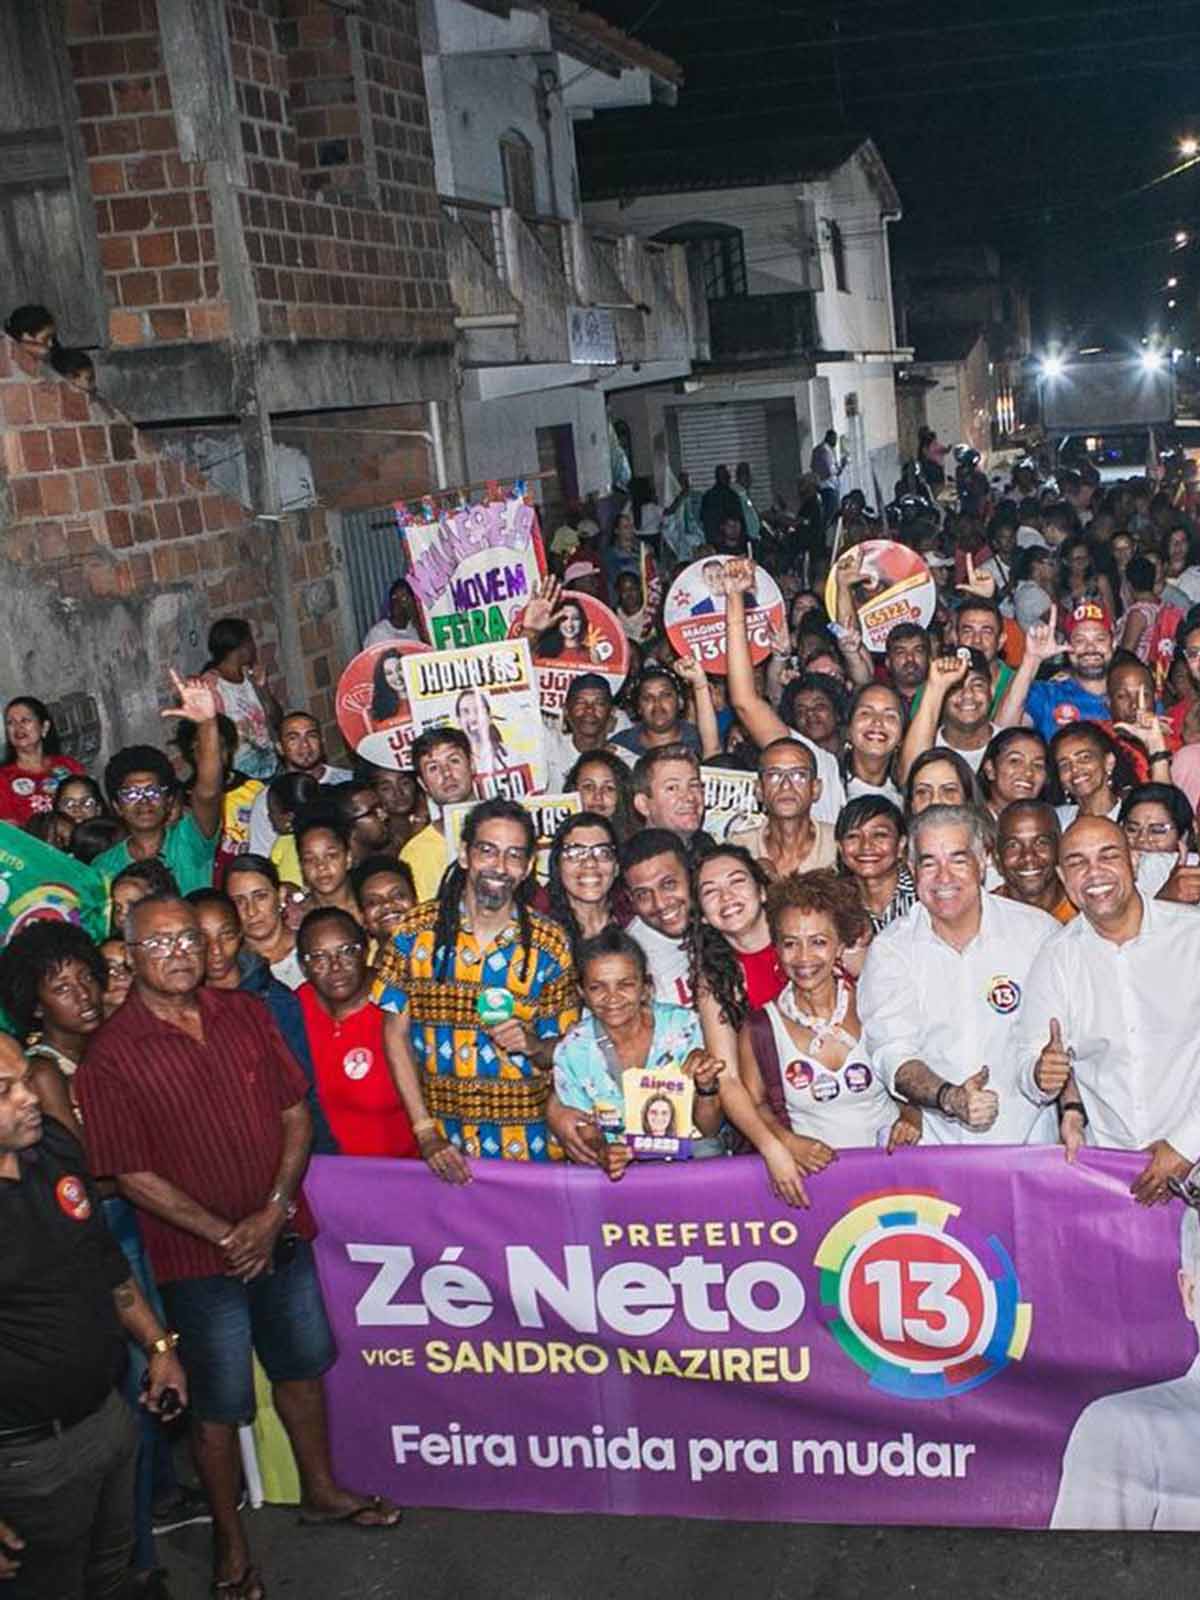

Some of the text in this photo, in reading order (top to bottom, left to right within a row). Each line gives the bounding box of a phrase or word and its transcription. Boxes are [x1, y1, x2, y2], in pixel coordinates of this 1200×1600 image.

[451, 562, 528, 613] MOVEM
[602, 1220, 799, 1247] PREFEITO
[345, 1243, 806, 1336] Zé Neto
[864, 1260, 971, 1348] 13
[361, 1341, 812, 1383] VICE SANDRO NAZIREU
[390, 1422, 977, 1481] Feira unida pra mudar
